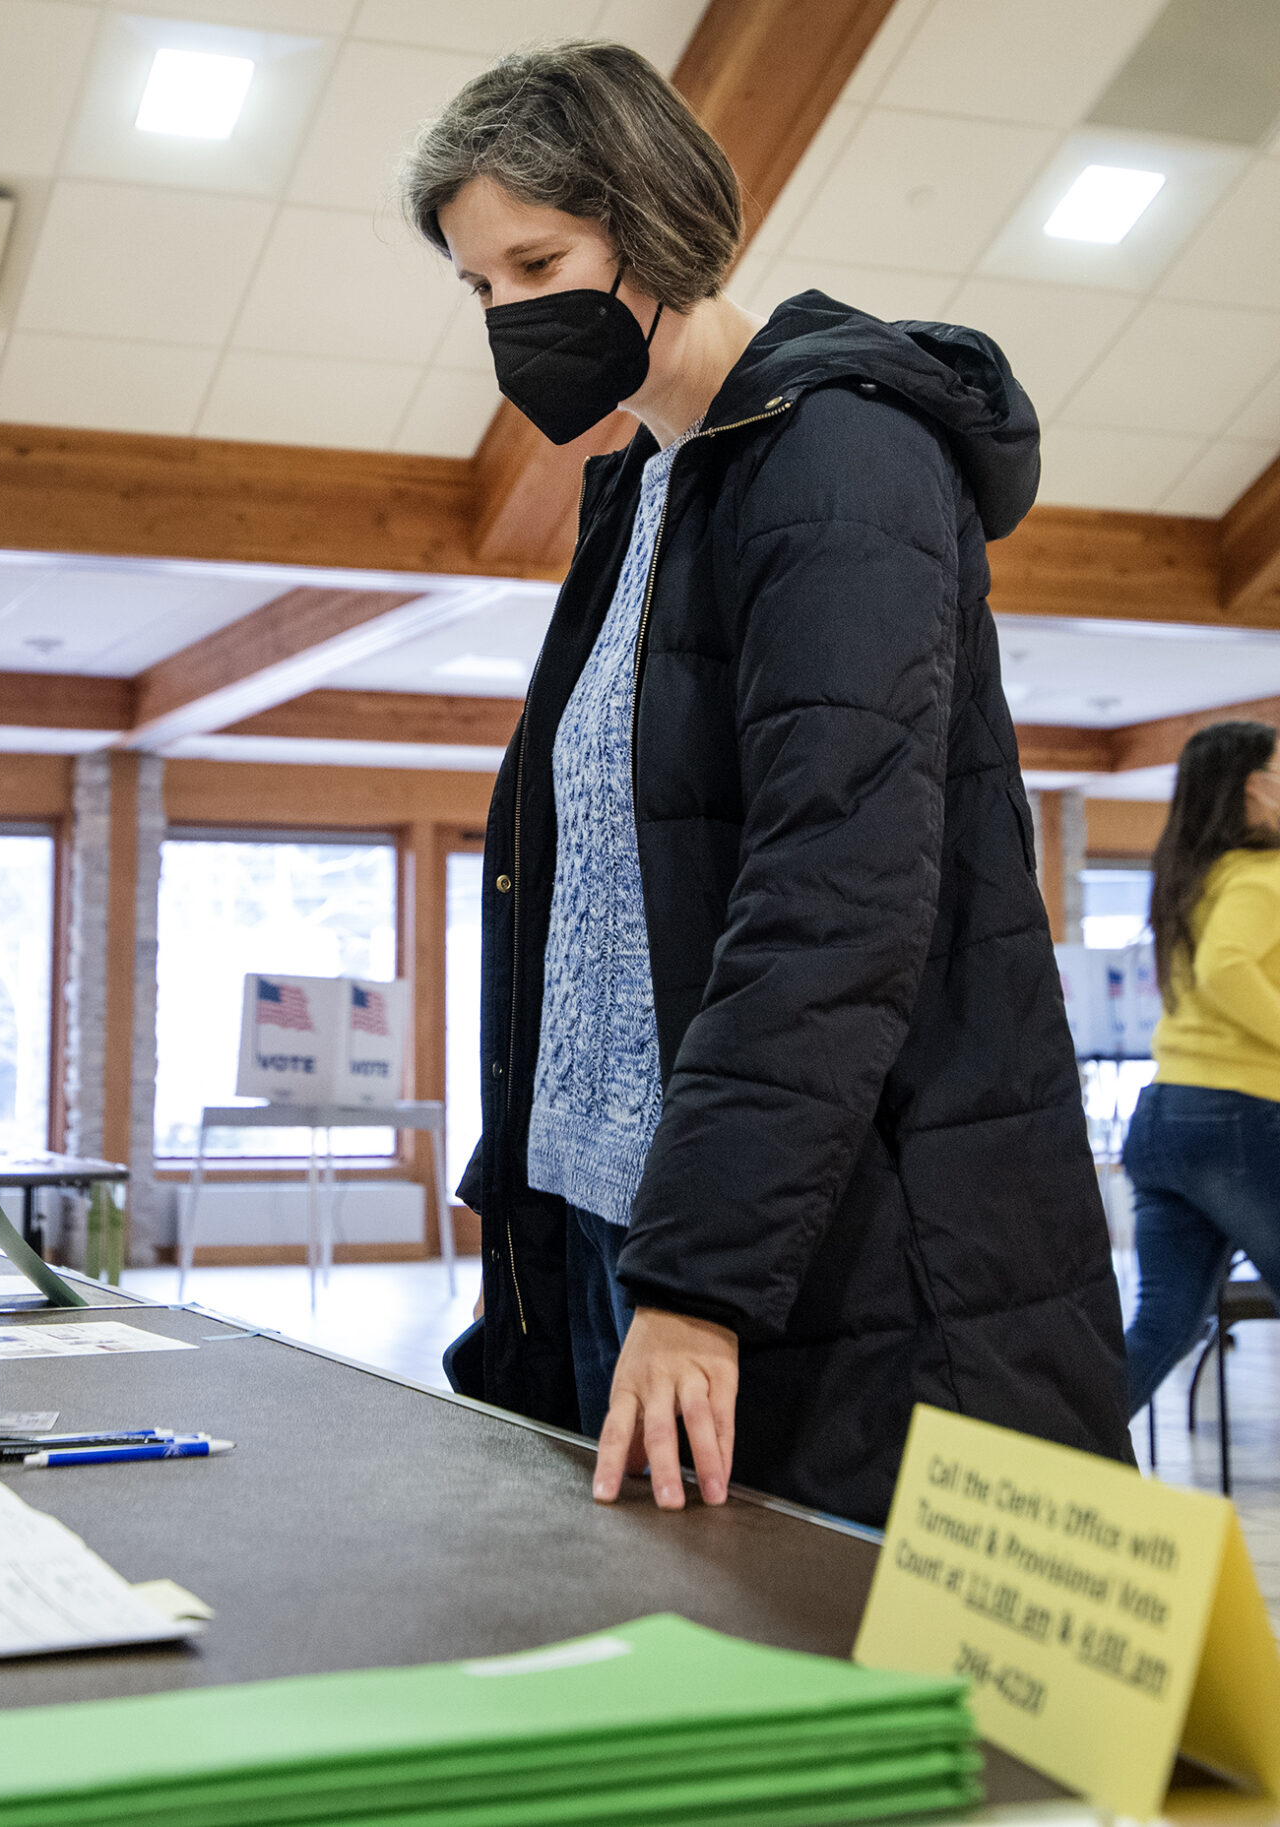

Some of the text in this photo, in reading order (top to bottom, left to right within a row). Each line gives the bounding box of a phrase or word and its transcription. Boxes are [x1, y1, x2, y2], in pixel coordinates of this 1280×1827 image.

[256, 1055, 316, 1075] VOTE
[350, 1060, 389, 1078] VOTE
[918, 1500, 1170, 1627] Turnout & Provisional Vote
[929, 1456, 959, 1490] Call
[964, 1470, 989, 1502] the
[1064, 1502, 1119, 1549] Office
[1131, 1535, 1176, 1571] with
[895, 1538, 943, 1584] Count
[946, 1565, 965, 1594] at
[1057, 1610, 1073, 1645] &
